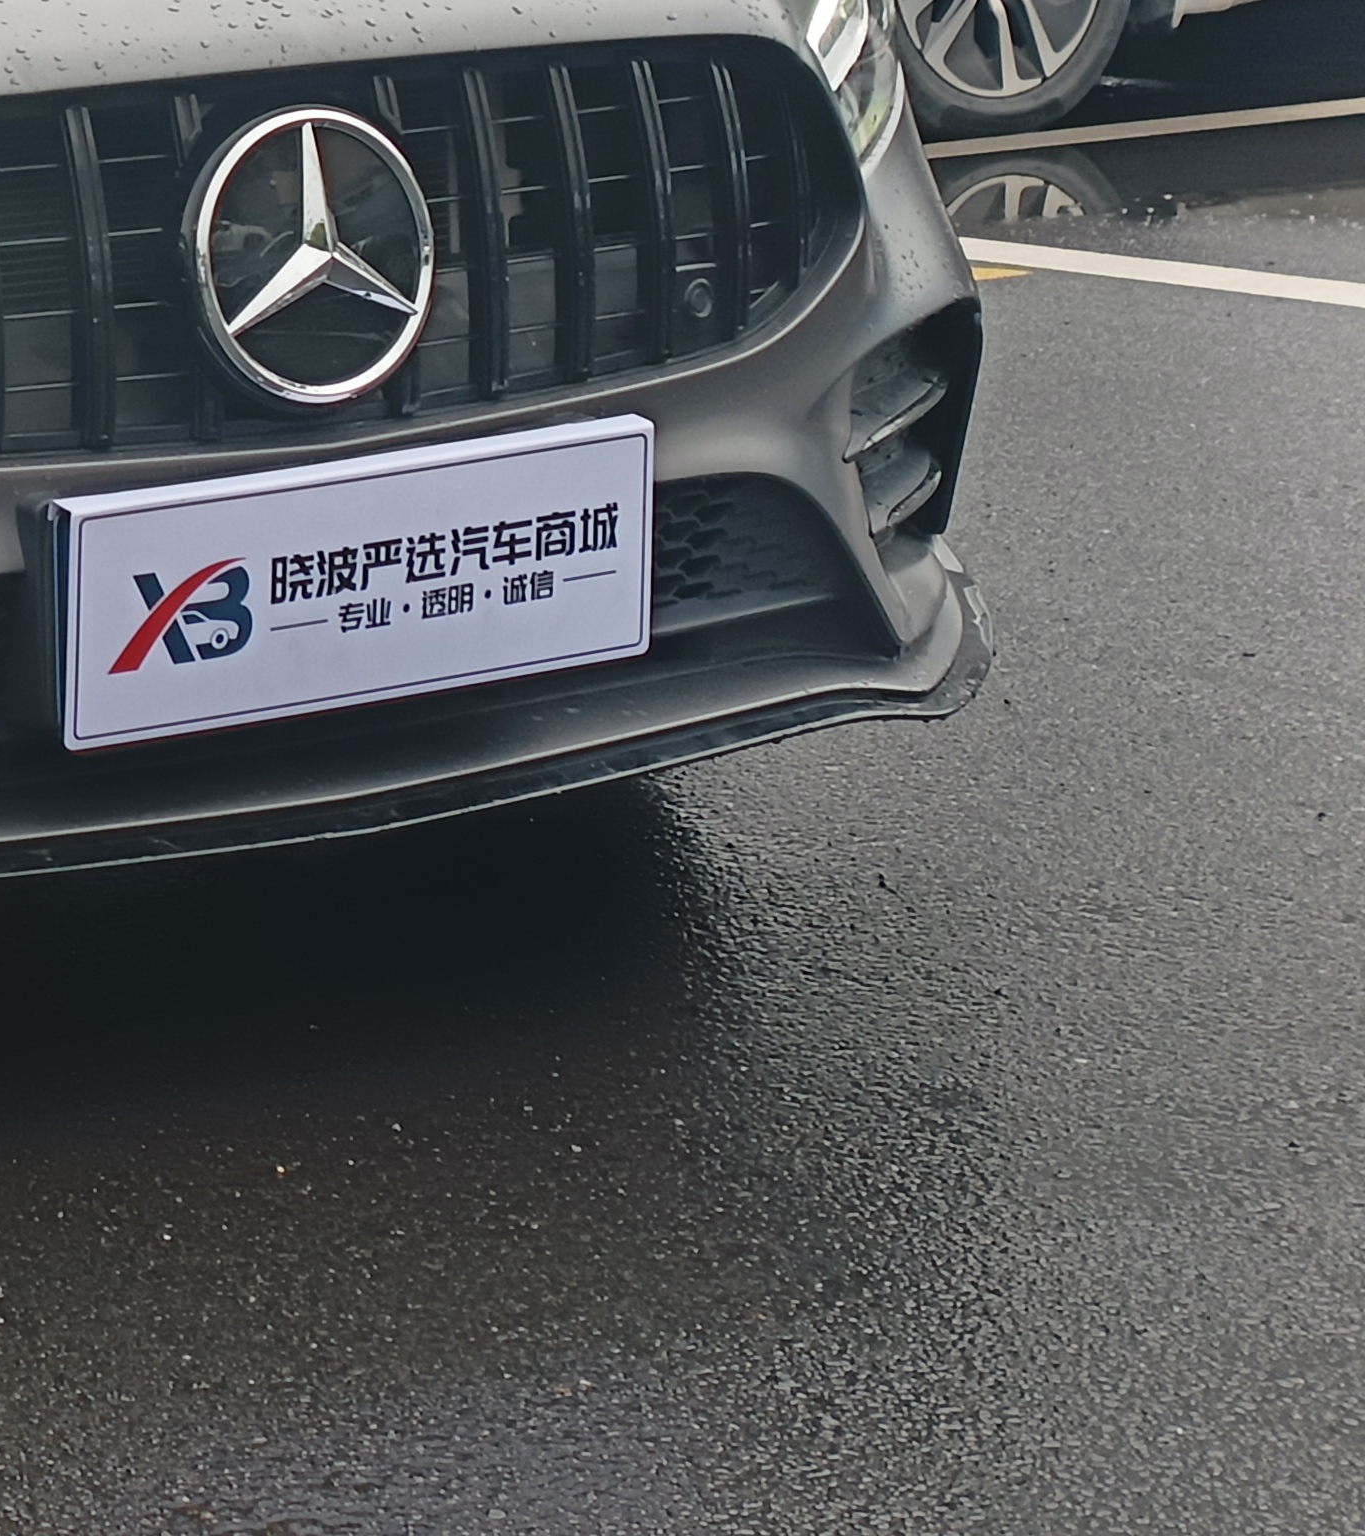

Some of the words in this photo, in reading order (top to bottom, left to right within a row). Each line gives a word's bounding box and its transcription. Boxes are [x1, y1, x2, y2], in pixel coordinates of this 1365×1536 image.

[270, 502, 619, 605] 晓波严选汽车商城
[338, 570, 555, 633] 专业·透明·诚信
